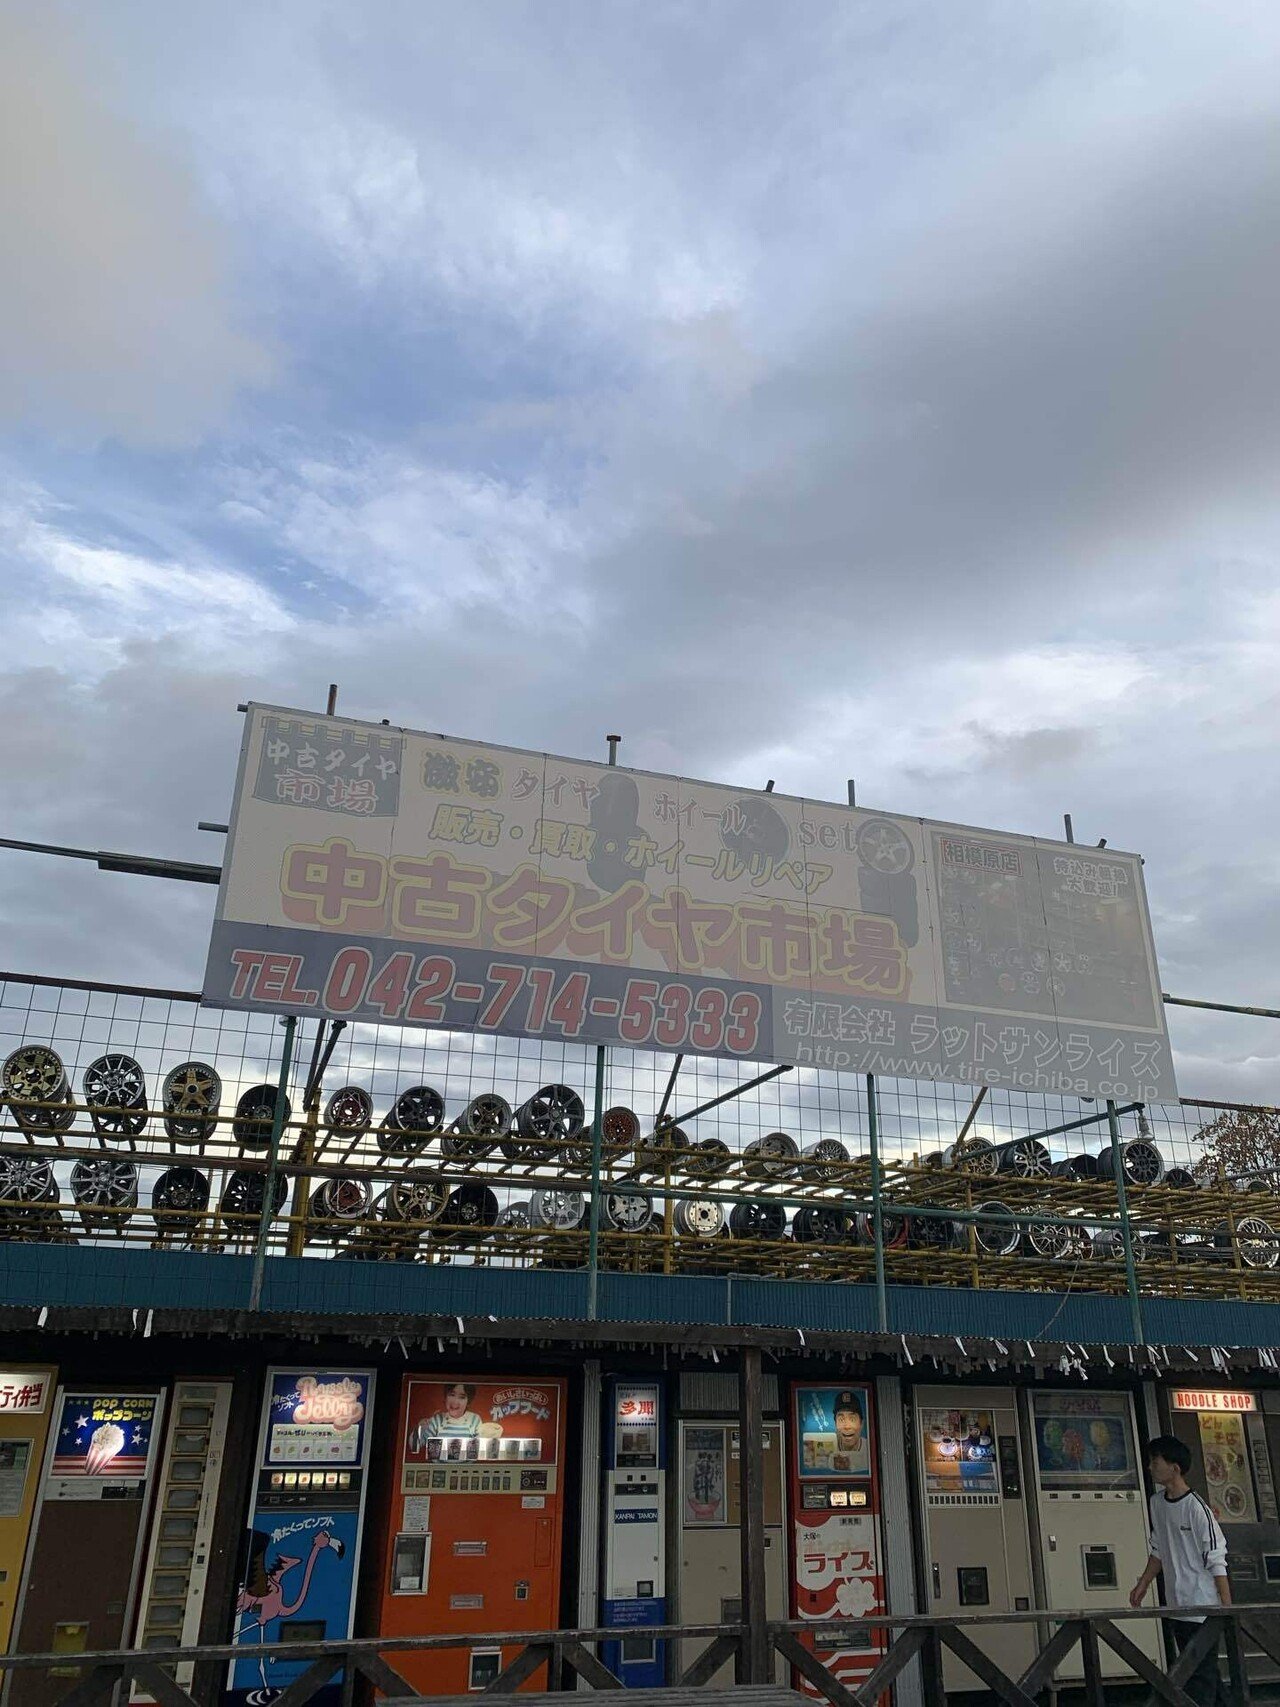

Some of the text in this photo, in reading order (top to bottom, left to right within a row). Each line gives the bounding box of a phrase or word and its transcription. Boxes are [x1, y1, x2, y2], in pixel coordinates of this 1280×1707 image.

[266, 737, 398, 781] 中古タイヤ
[275, 768, 379, 814] 市場
[511, 767, 858, 854] タイヤ ホイール set
[280, 837, 908, 995] 中古タイヤ市場
[231, 946, 763, 1054] TEL. 042-714-5333
[784, 998, 1162, 1079] 有限会社 ラットサンライス
[796, 1042, 1159, 1102] http://www.tire-ichiba.co.jp
[0, 1383, 43, 1408] ティ弁当
[1177, 1393, 1251, 1409] NOODLE SHOP
[804, 1551, 873, 1574] ライス
